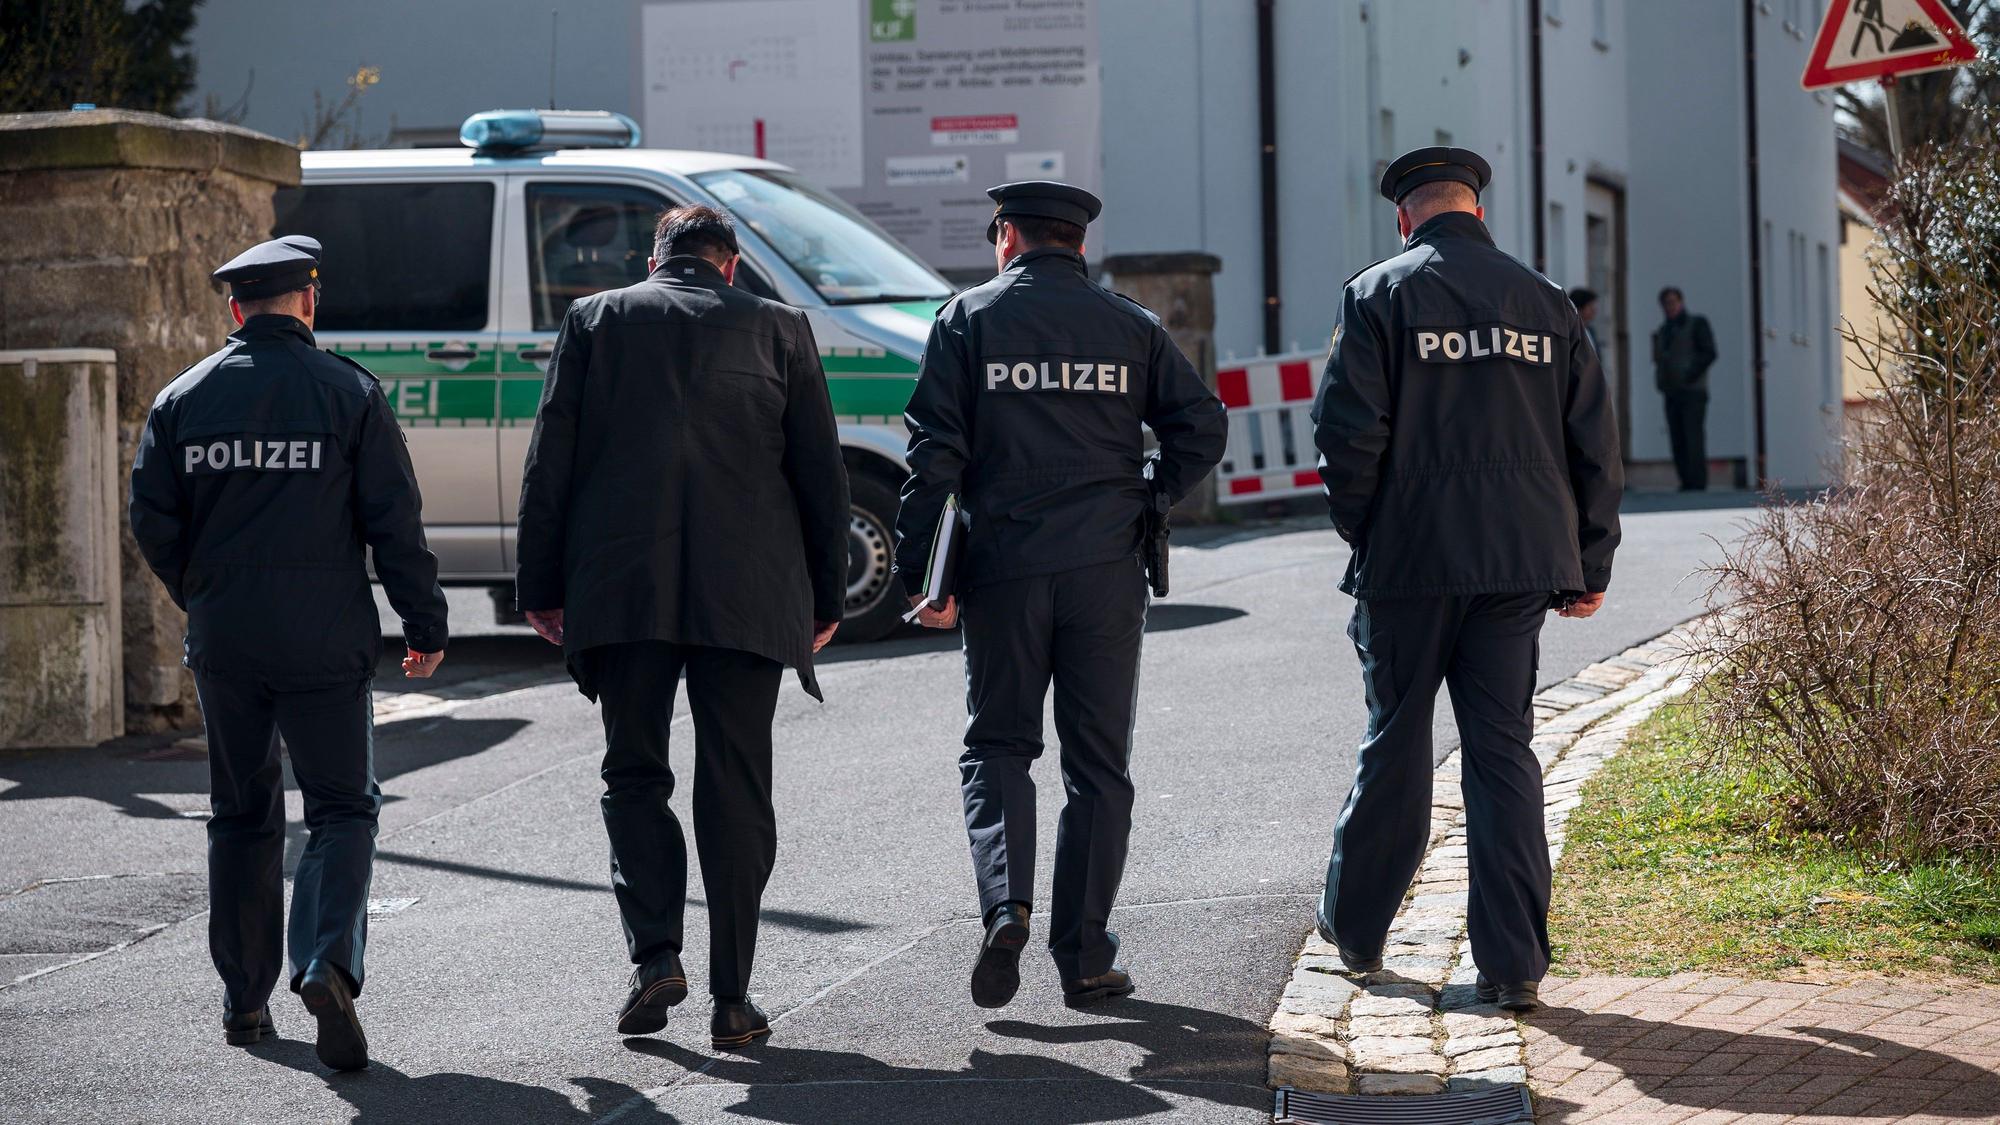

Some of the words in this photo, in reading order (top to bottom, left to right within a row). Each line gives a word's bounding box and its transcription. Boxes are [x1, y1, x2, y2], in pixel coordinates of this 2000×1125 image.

[1417, 327, 1552, 363] POLIZEI
[986, 362, 1128, 393] POLIZEI
[185, 440, 321, 473] POLIZEI
